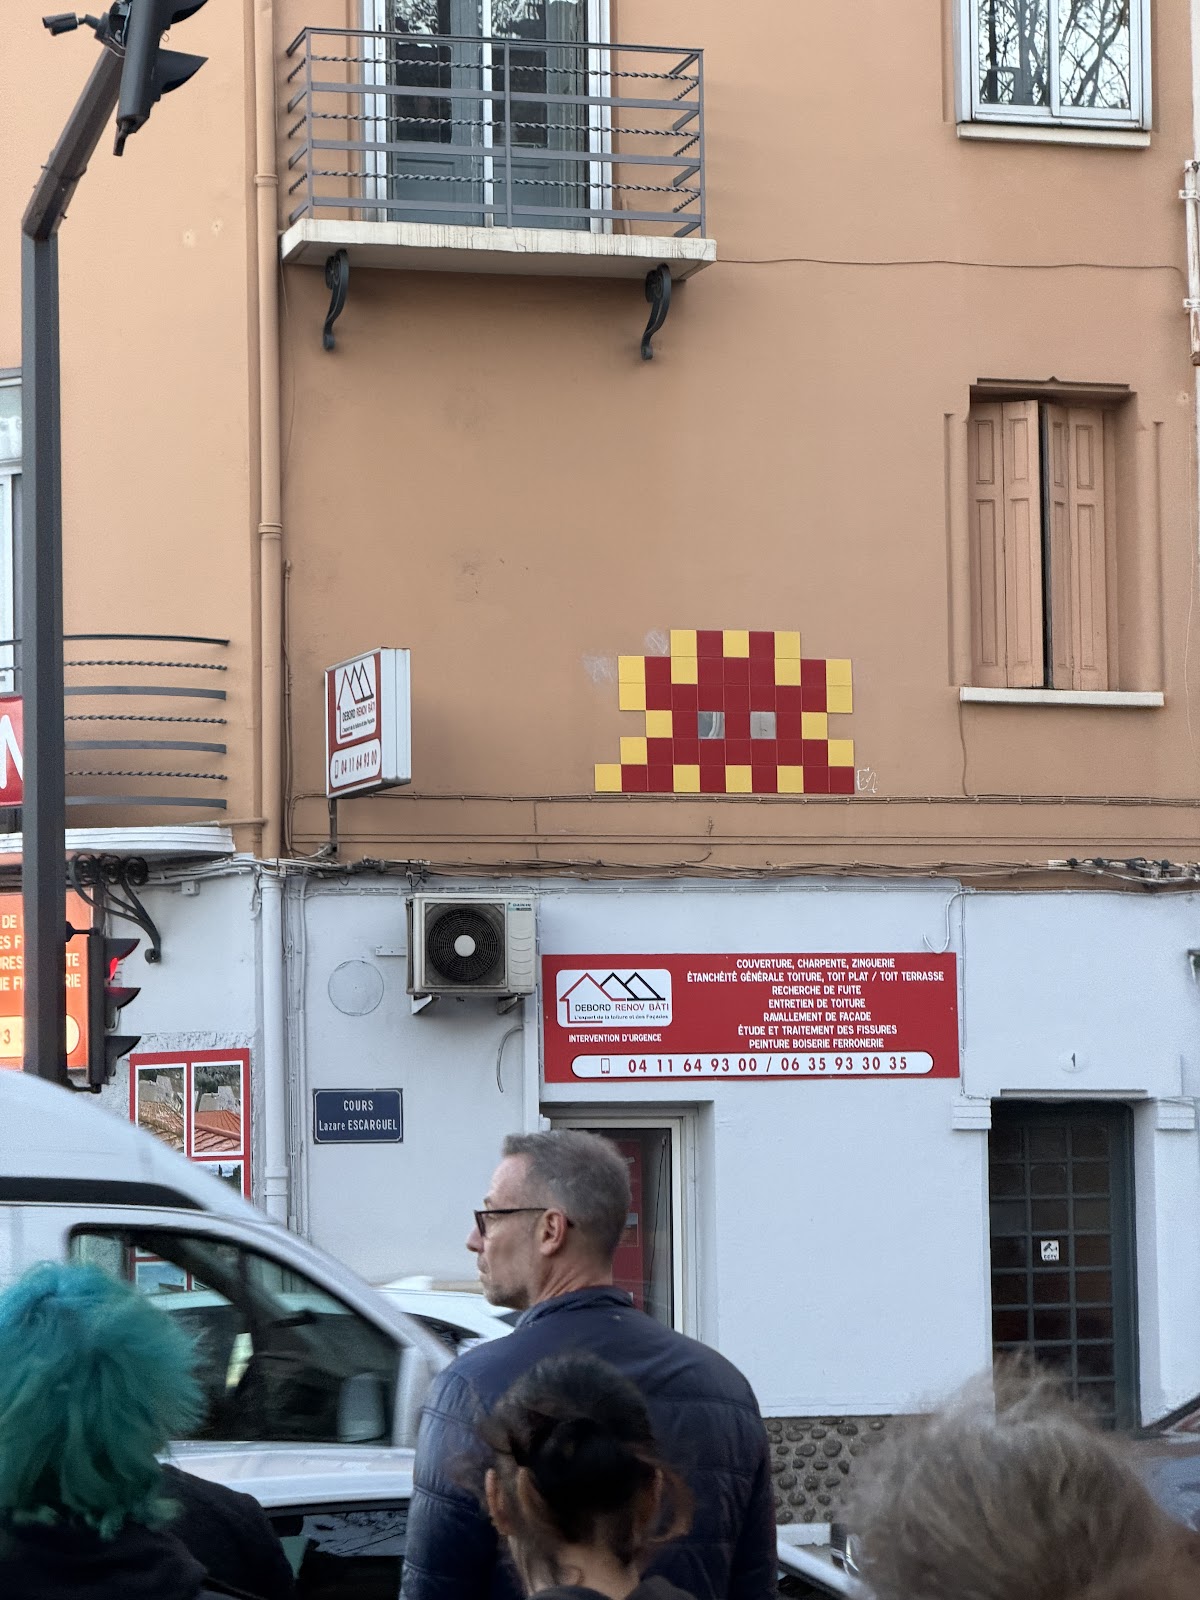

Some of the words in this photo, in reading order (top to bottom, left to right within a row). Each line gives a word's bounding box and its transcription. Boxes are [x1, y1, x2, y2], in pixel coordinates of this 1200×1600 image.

[341, 758, 347, 775] 04
[350, 757, 354, 772] 11
[356, 754, 362, 771] 64
[364, 751, 370, 768] 93
[371, 749, 377, 766] 00
[737, 959, 795, 969] COUVERTURE,
[797, 959, 849, 969] CHARPENTE,
[852, 958, 895, 968] ZINGUERIE
[687, 970, 738, 982] ÉTANCHÉITÉ
[740, 970, 784, 982] GÉNÉRALE
[787, 971, 825, 983] TOITURE,
[827, 971, 845, 982] TOIT
[848, 971, 868, 982] PLAT
[871, 971, 877, 982] /
[880, 971, 898, 982] TOIT
[901, 971, 944, 981] TERRASSE
[772, 985, 821, 995] RECHERCHE
[823, 985, 835, 995] DE
[838, 985, 861, 995] FUITE
[574, 1003, 611, 1012] DEBORD
[615, 1003, 645, 1011] RENOV
[769, 998, 814, 1008] ENTRETIEN
[817, 998, 828, 1008] DE
[831, 998, 866, 1008] TOITURE
[764, 1012, 822, 1022] RAVALLEMENT
[825, 1012, 836, 1021] DE
[738, 1024, 765, 1035] ÉTUDE
[768, 1026, 779, 1035] ET
[782, 1025, 834, 1035] TRAITEMENT
[837, 1025, 854, 1035] DES
[857, 1025, 897, 1035] FISSURES
[569, 1034, 620, 1042] INTERVENTION
[622, 1033, 662, 1042] D'URGENCE
[749, 1039, 790, 1049] PEINTURE
[793, 1038, 830, 1048] BOISERIE
[833, 1038, 884, 1048] FERRONERIE
[628, 1059, 647, 1073] 04
[657, 1059, 673, 1072] 11
[683, 1059, 702, 1072] 64
[711, 1058, 729, 1072] 93
[738, 1058, 757, 1071] 00
[766, 1056, 772, 1072] /
[781, 1057, 799, 1071] 06
[808, 1057, 826, 1071] 35
[835, 1057, 853, 1070] 93
[862, 1056, 880, 1070] 30
[889, 1056, 907, 1070] 35
[343, 1099, 373, 1111] COURS
[319, 1120, 346, 1131] Lazare
[348, 1119, 397, 1131] ESCARGUEL
